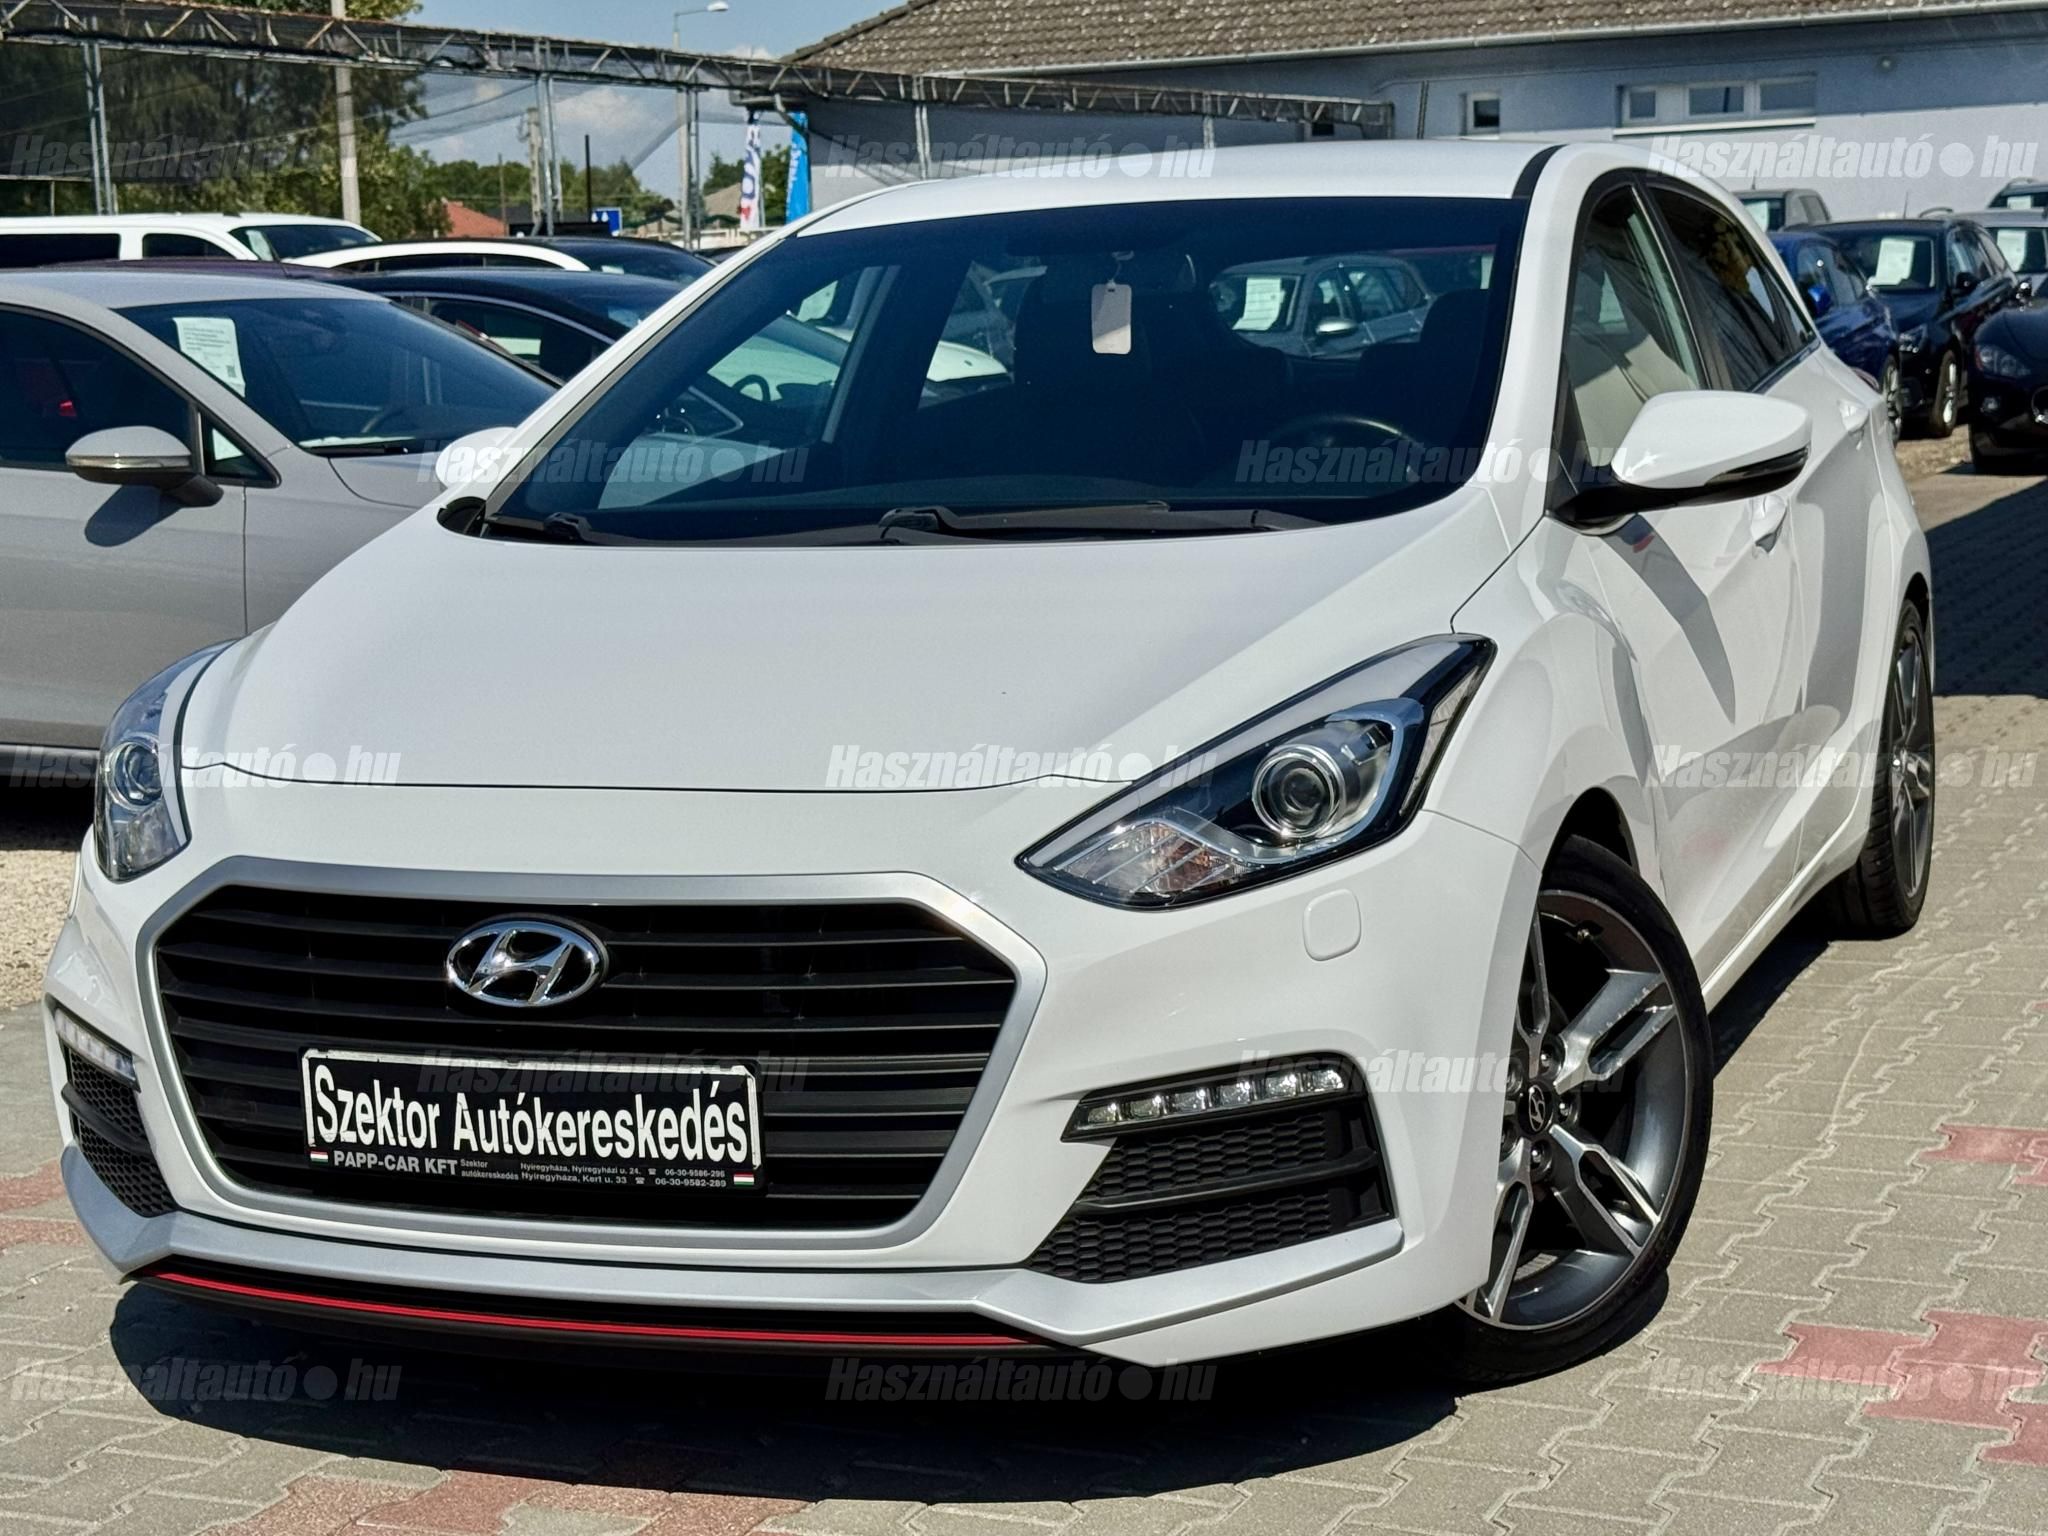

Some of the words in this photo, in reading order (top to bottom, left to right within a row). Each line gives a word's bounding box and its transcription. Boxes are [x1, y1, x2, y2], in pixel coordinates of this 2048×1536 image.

[314, 1064, 440, 1149] Szektor
[453, 1080, 748, 1163] Autókereskedés
[333, 1150, 420, 1173] PAPP-CAR
[425, 1157, 458, 1176] KFT
[460, 1158, 488, 1168] Szektor
[461, 1170, 519, 1181] autókereskedés
[604, 1176, 613, 1184] u.
